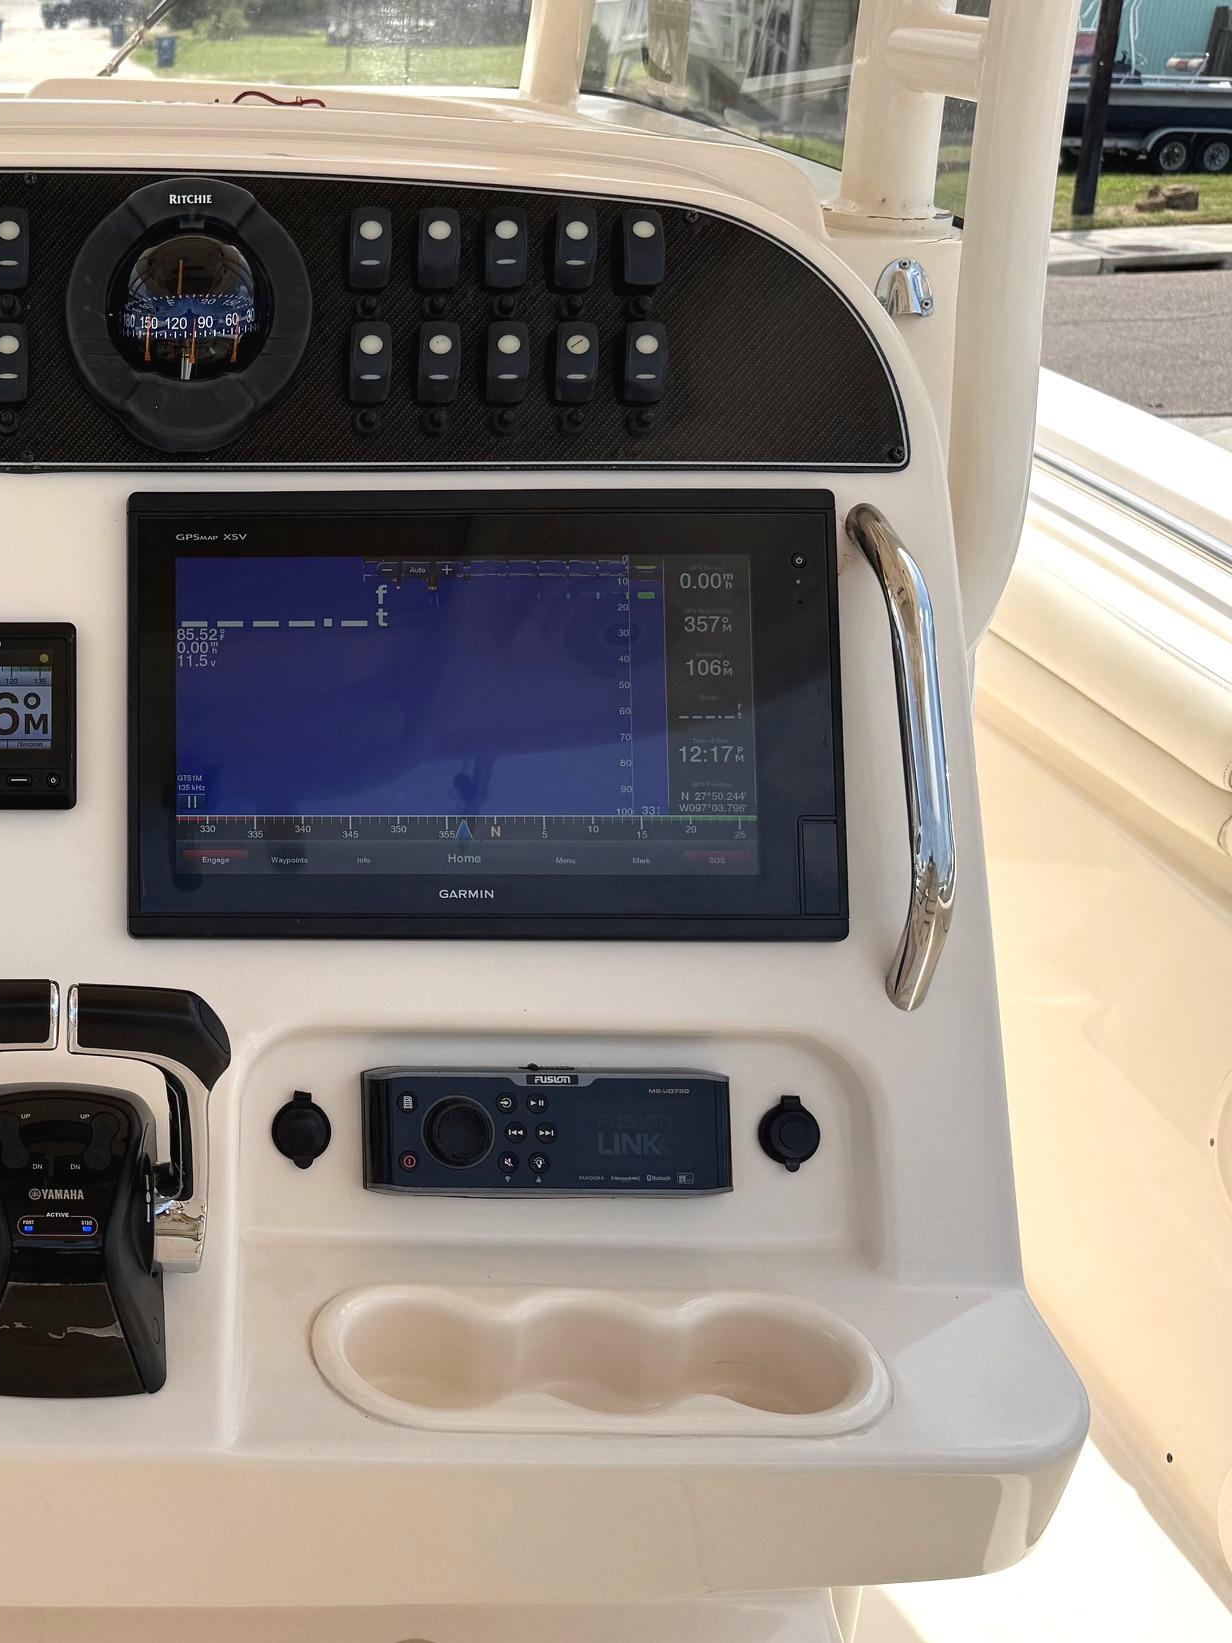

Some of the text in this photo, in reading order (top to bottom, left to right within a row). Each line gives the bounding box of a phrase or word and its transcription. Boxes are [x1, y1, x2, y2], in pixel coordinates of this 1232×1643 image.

[169, 194, 213, 204] RITCHIE
[140, 315, 158, 330] 150
[166, 316, 188, 330] 120
[197, 316, 214, 329] 90
[225, 313, 239, 326] 60
[223, 533, 248, 541] XSV
[679, 573, 721, 589] 0.00
[617, 603, 629, 612] 20
[177, 628, 218, 641] 85.52
[618, 629, 629, 638] 30
[177, 641, 209, 654] 0.00
[177, 654, 208, 667] 11.5
[618, 655, 630, 663] 40
[619, 681, 630, 689] 50
[619, 707, 631, 715] 60
[620, 733, 632, 741] 70
[678, 745, 734, 763] 12:17
[621, 785, 633, 793] 90
[681, 792, 689, 801] N
[616, 808, 633, 816] 100
[200, 825, 746, 839] 330 335 340 345 350 355 N 5 10 15 20 25
[202, 856, 230, 865] Engage
[271, 856, 308, 865] Waypoints
[356, 856, 371, 864] Info
[447, 854, 481, 864] Home
[555, 857, 576, 865] Menu
[439, 889, 494, 899] GARMIN
[597, 1132, 665, 1156] LINK
[41, 1189, 84, 1200] YAMAHA
